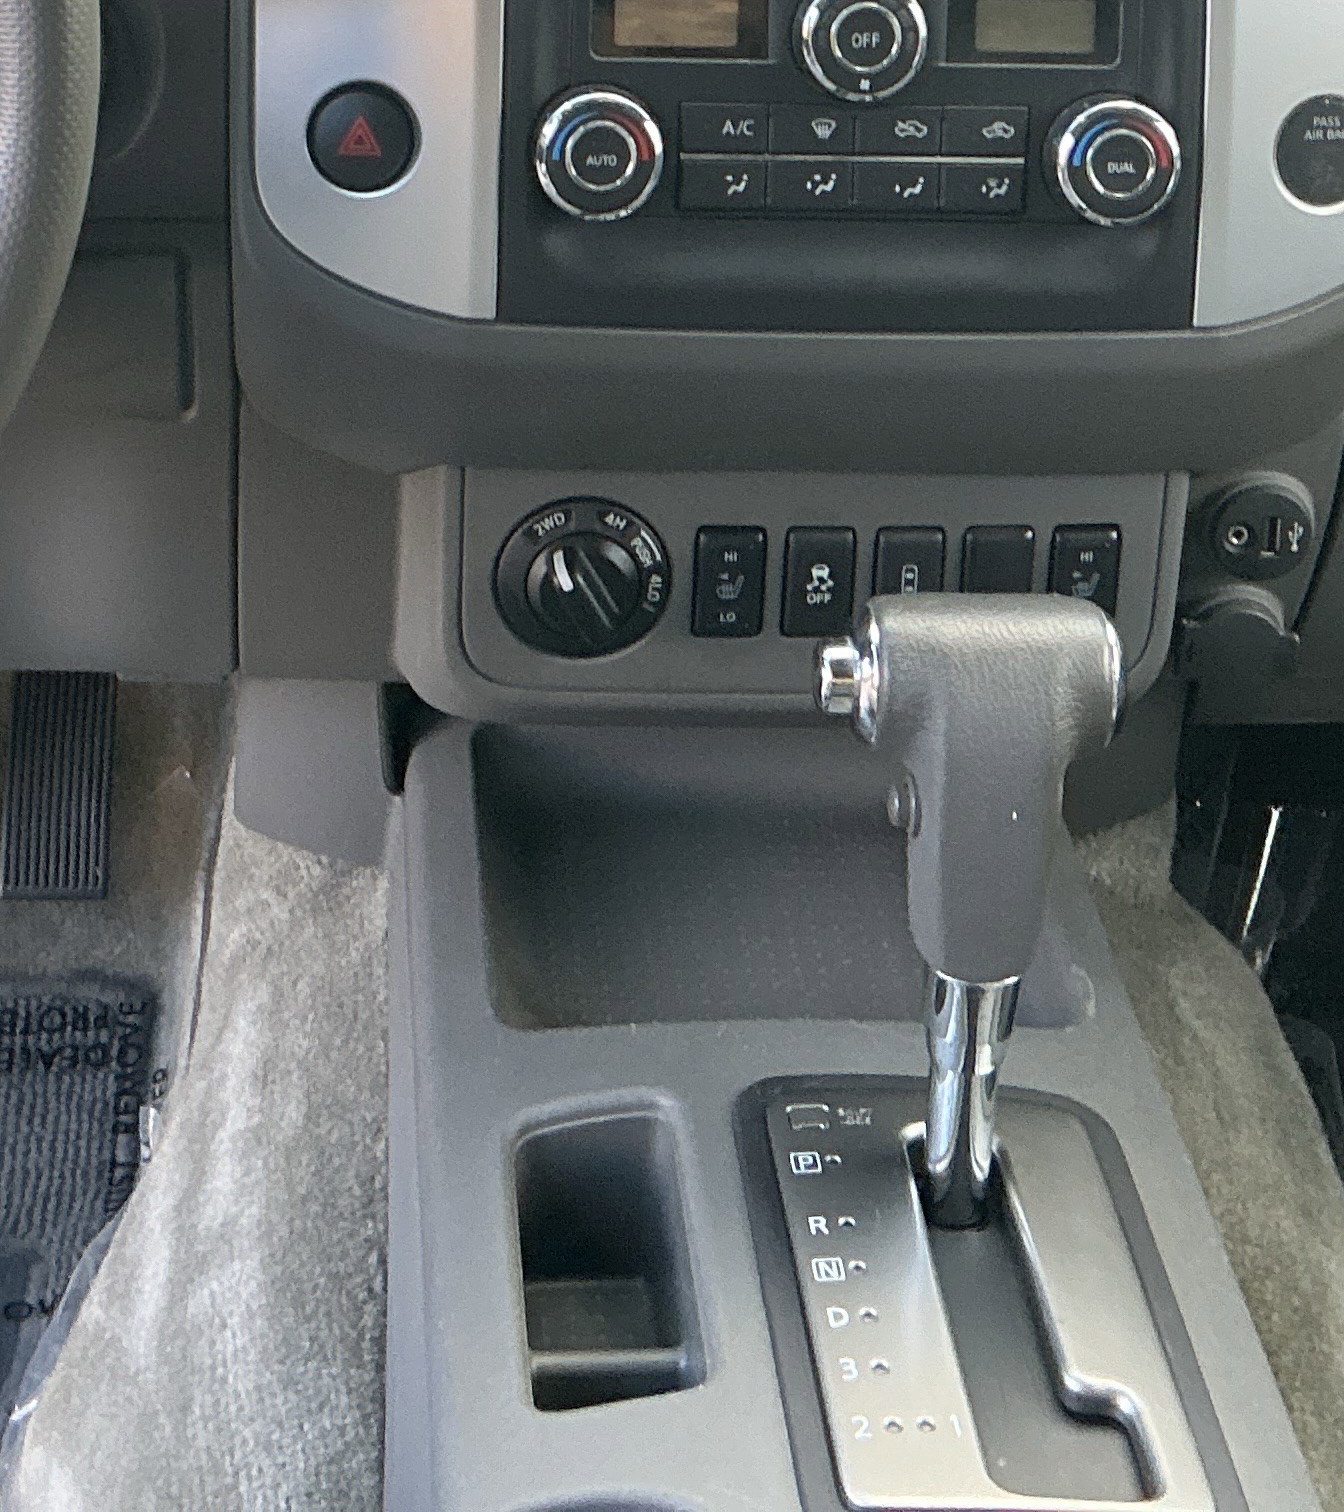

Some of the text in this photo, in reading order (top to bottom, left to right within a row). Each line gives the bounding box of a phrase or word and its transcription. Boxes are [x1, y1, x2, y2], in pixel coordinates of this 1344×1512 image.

[850, 31, 881, 50] OFF
[721, 118, 755, 138] A/C
[1312, 115, 1342, 128] PASS
[1303, 128, 1325, 141] AIR
[585, 153, 618, 168] AUTO
[1106, 160, 1137, 175] DUAL
[532, 511, 567, 538] 2WD
[603, 510, 629, 532] 4H
[723, 550, 739, 564] HI
[1079, 550, 1095, 564] HI
[805, 591, 833, 606] OFF
[718, 611, 737, 624] LO
[797, 1154, 815, 1172] P
[808, 1214, 829, 1236] R
[818, 1260, 841, 1279] N
[826, 1307, 850, 1329] D
[839, 1357, 859, 1381] 3
[852, 1417, 873, 1440] 2
